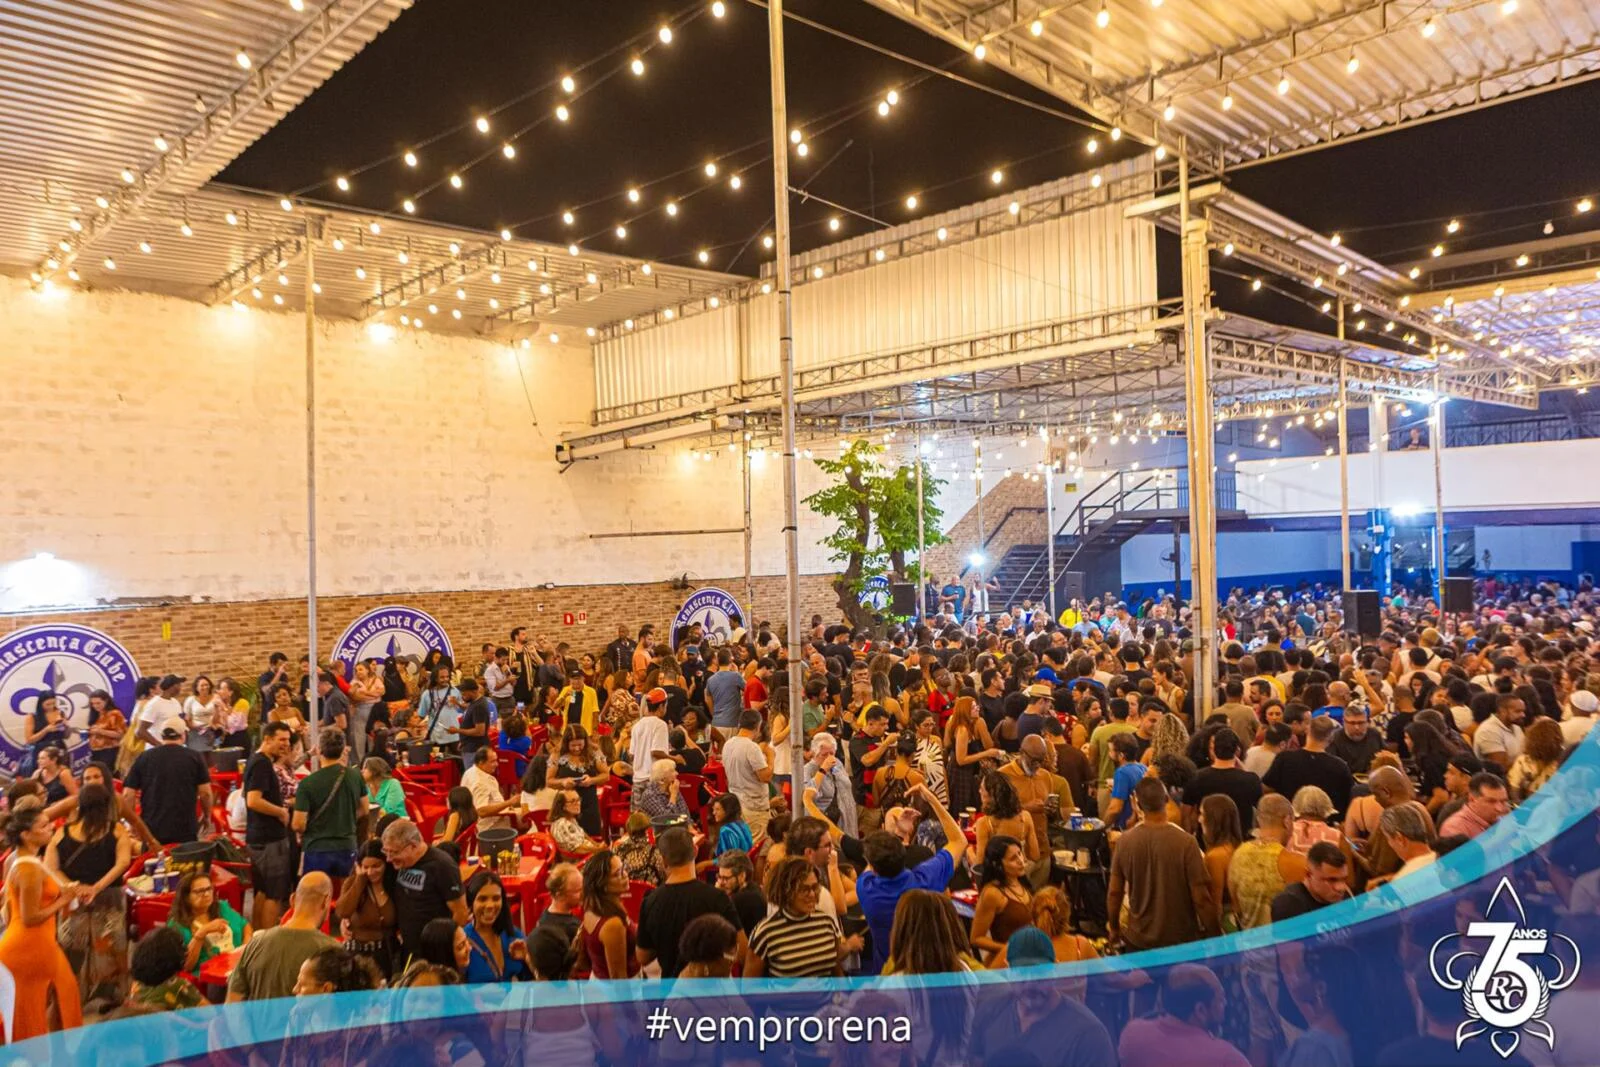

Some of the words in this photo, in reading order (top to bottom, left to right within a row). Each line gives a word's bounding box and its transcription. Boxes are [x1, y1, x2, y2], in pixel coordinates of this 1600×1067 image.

[721, 599, 736, 616] Clu
[0, 636, 80, 673] nascença
[82, 640, 126, 683] Clube
[338, 615, 411, 662] Renascença
